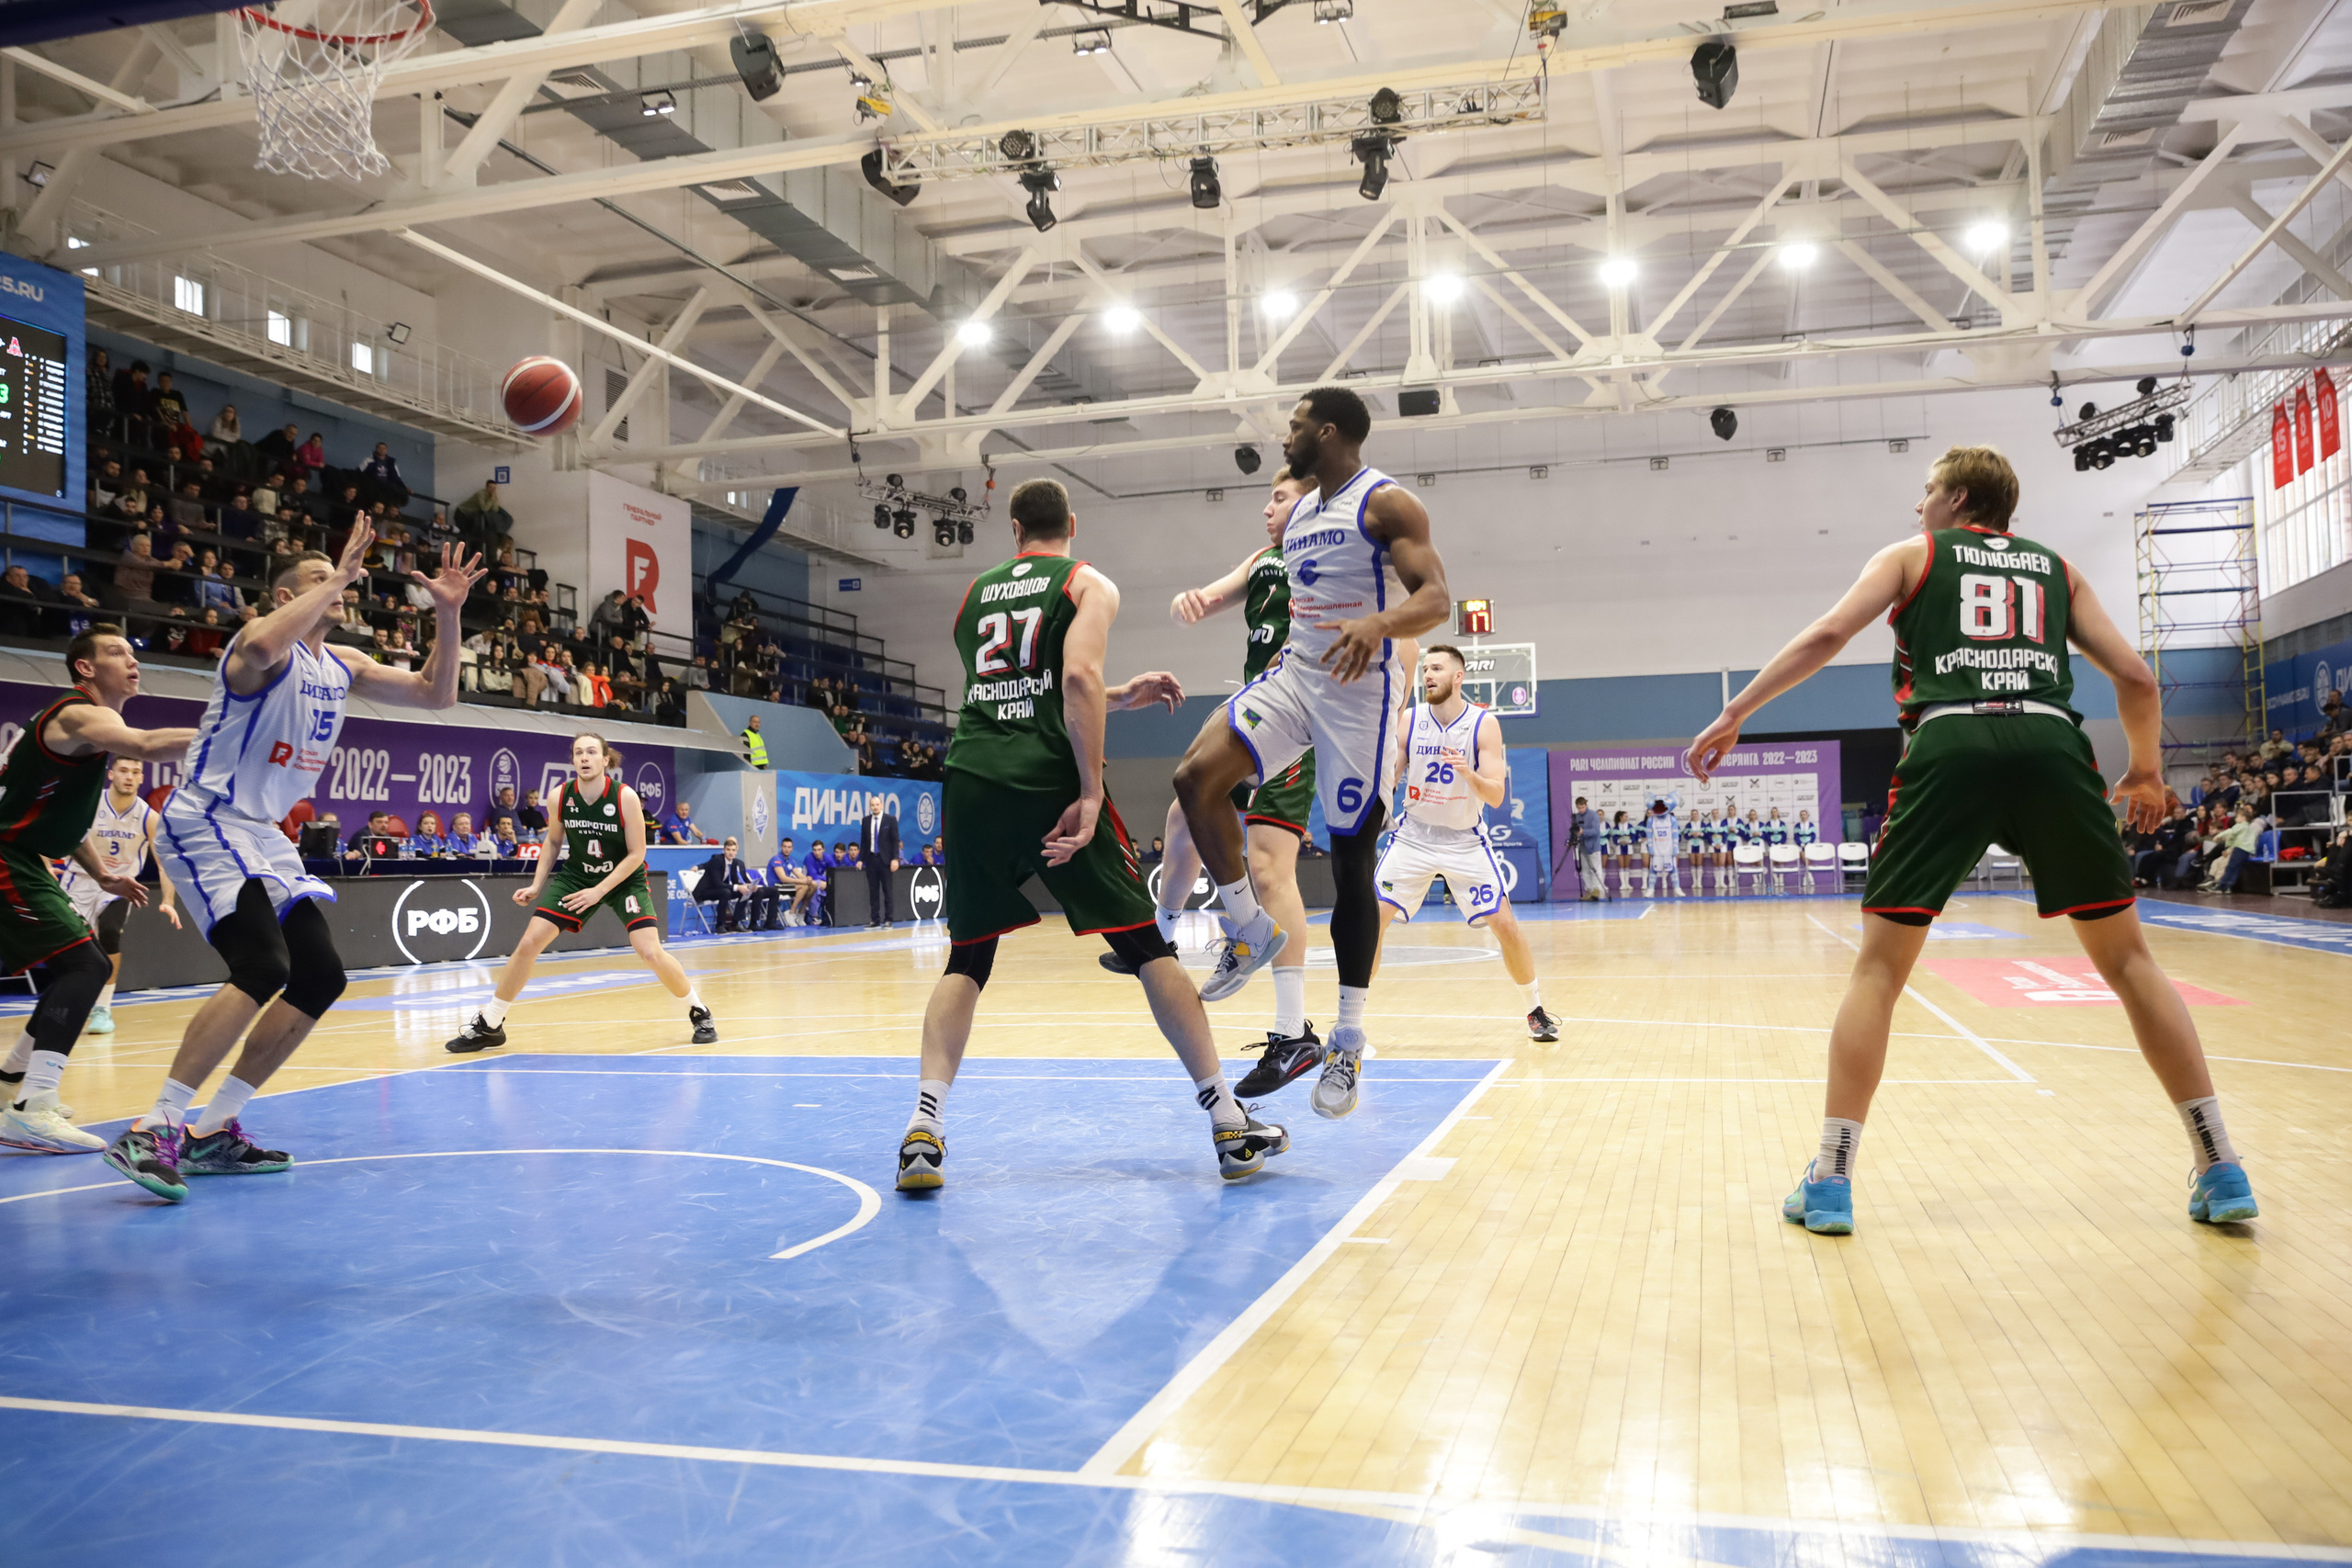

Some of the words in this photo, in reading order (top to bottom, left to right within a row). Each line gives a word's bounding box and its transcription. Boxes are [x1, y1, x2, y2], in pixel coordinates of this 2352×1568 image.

[1297, 558, 1319, 586] 6
[1952, 545, 2052, 576] ТЮЛЮБАЕВ
[980, 576, 1051, 604] ШУХОВЦОВ
[1960, 573, 2045, 645] 81
[1473, 612, 1489, 632] 17
[976, 606, 1044, 677] 27
[1935, 647, 2059, 685] КРАСНОДАРСК
[1981, 670, 2030, 691] КРАЙ
[998, 697, 1035, 721] КРАЙ
[309, 708, 336, 741] 15
[1416, 745, 1465, 757] ДИНО
[1709, 752, 1759, 767] ПЕРЛИГА
[1425, 761, 1454, 784] 26
[1570, 758, 1589, 772] PARI
[1641, 755, 1675, 770] РОССИИ
[639, 782, 662, 798] РФБ
[1337, 777, 1364, 814] 6
[564, 818, 618, 833] ЛОКОМОТИВ
[109, 840, 119, 855] 3
[587, 839, 605, 859] 4
[625, 895, 641, 914] 4
[915, 885, 939, 904] РФБ
[1469, 884, 1494, 907] 26
[407, 908, 479, 937] РФБ
